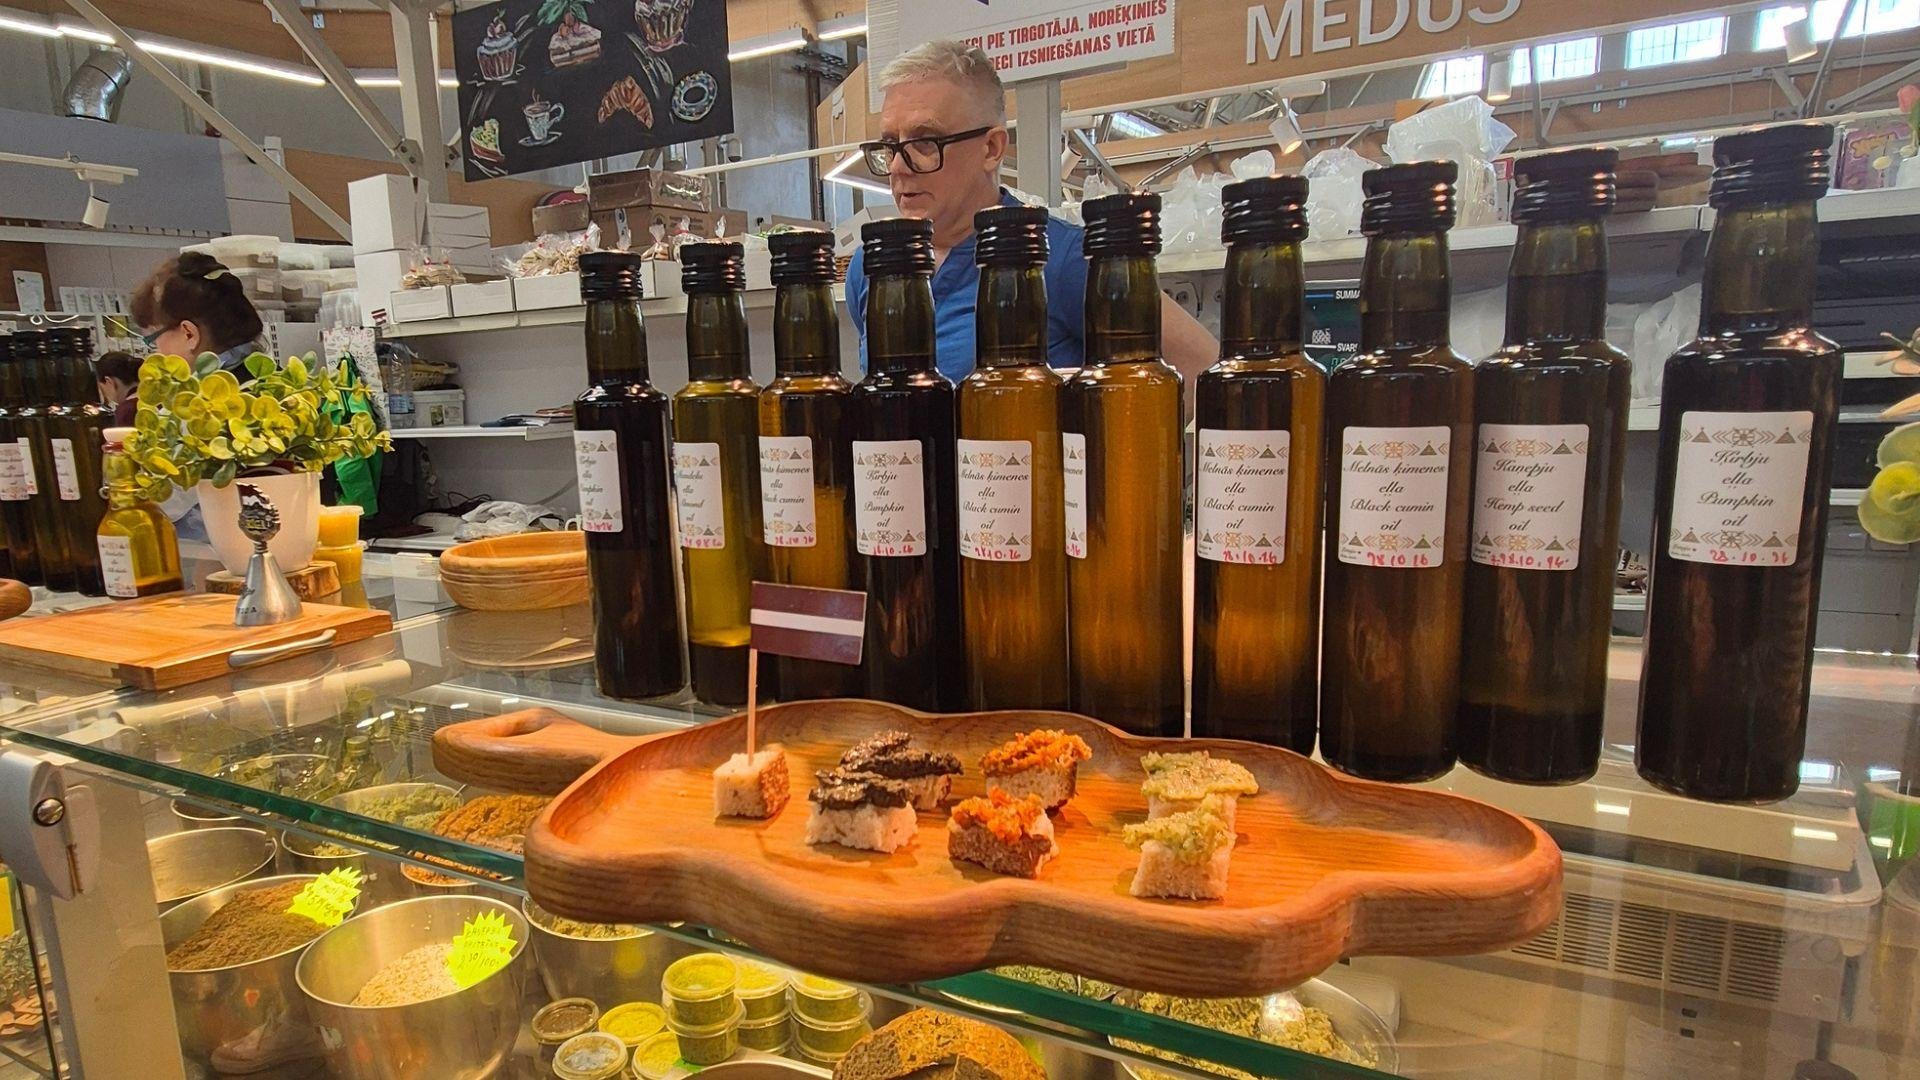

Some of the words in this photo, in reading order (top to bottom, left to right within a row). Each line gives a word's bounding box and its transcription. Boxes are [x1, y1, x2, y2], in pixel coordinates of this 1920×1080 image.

[987, 32, 1005, 50] PIE
[1017, 35, 1111, 66] IZSNIEGŠANAS
[1117, 23, 1156, 48] VIETĀ
[1202, 497, 1235, 512] Black
[1237, 502, 1276, 513] cumin
[1350, 498, 1391, 513] Black
[1395, 502, 1434, 512] cumin
[1484, 497, 1524, 515] Hemp
[1527, 500, 1565, 513] seed
[1697, 491, 1774, 511] Pumpkin
[864, 501, 905, 516] Pumpkin
[989, 504, 1021, 515] cumin
[876, 517, 891, 528] oil
[980, 519, 996, 530] oil
[1226, 518, 1244, 529] oil
[1380, 519, 1402, 531] oil
[1508, 519, 1531, 531] oil
[1722, 514, 1748, 527] oil
